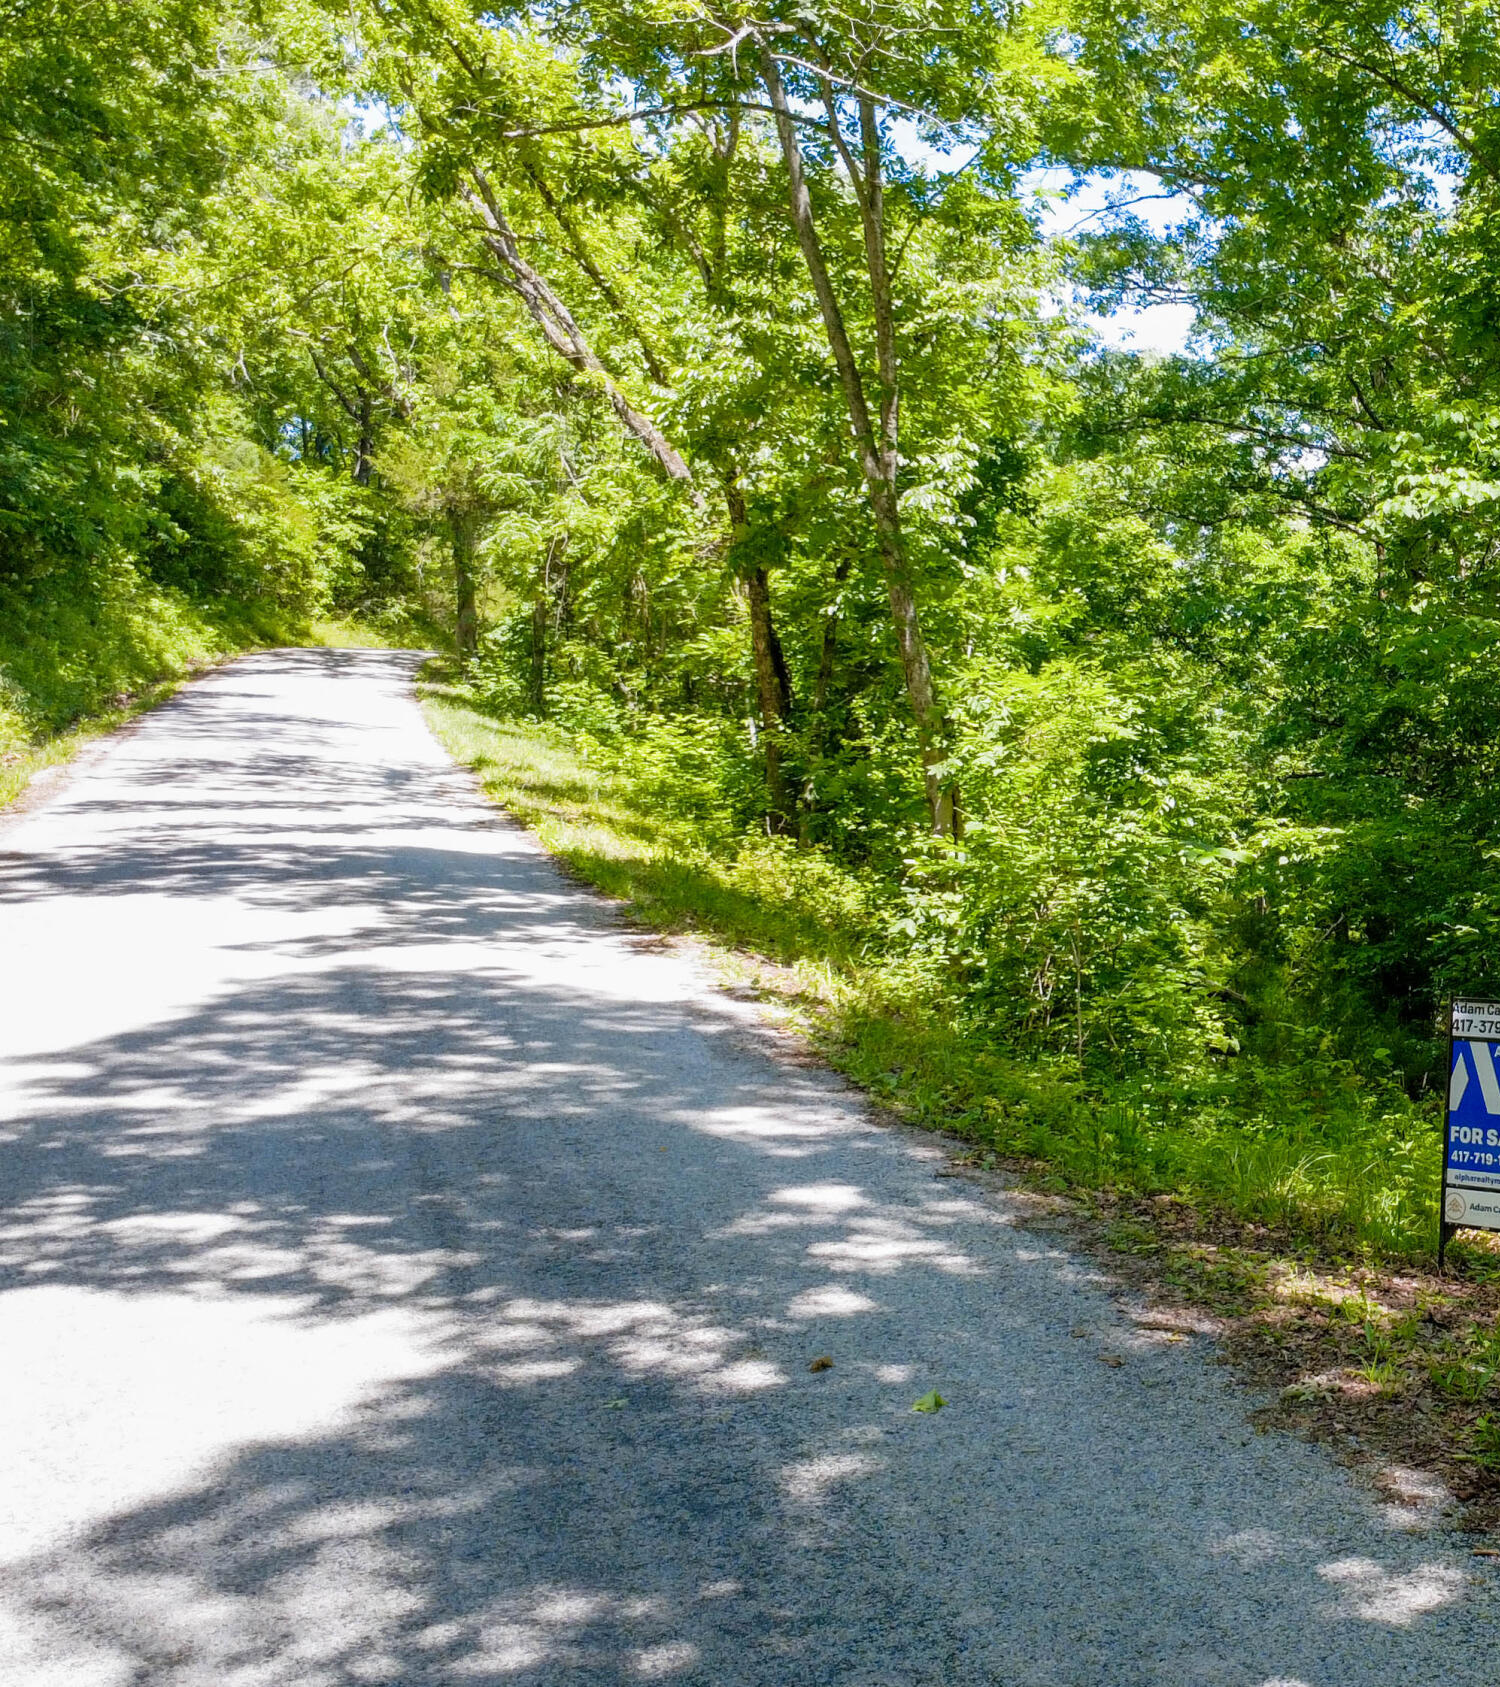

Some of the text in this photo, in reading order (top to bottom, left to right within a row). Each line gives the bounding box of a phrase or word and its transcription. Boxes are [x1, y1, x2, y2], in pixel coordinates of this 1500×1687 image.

[1453, 1002, 1485, 1015] Adam
[1451, 1126, 1483, 1144] FOR
[1469, 1203, 1492, 1213] Adam
